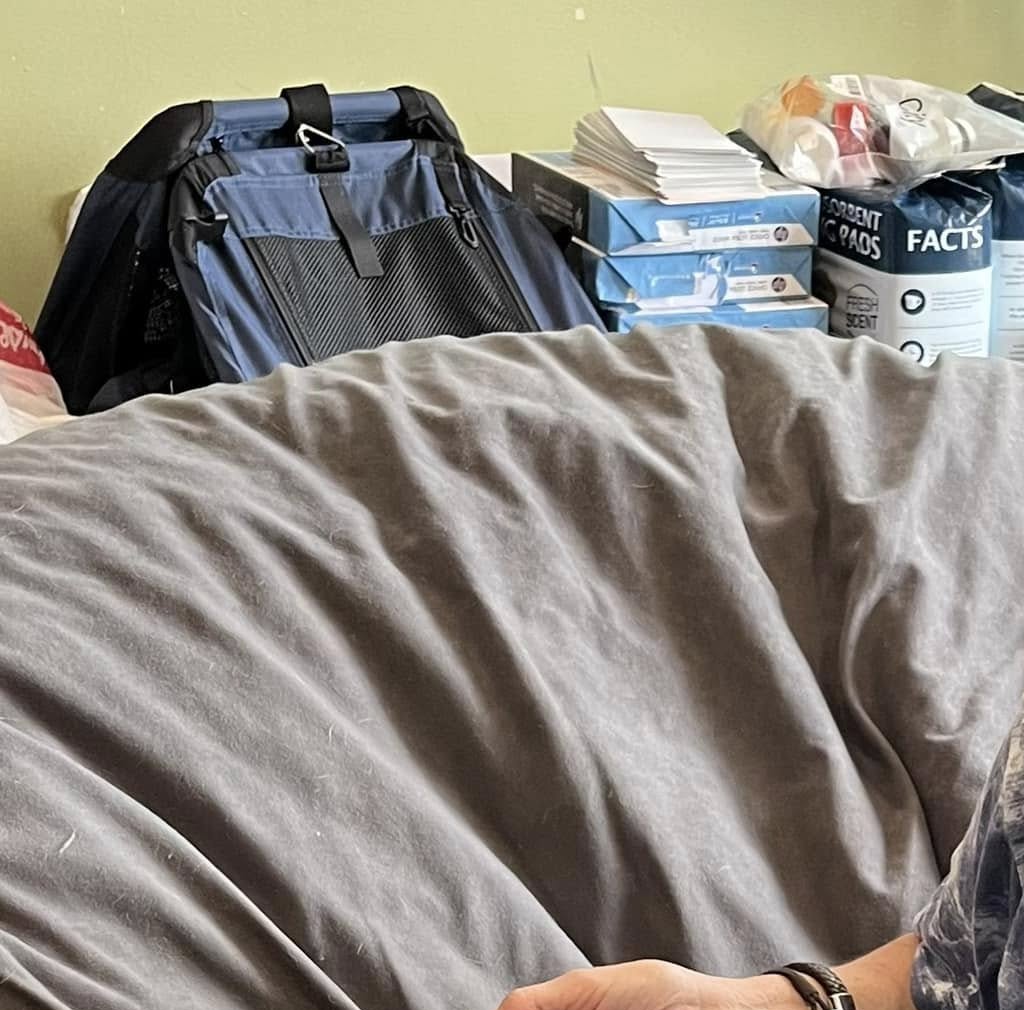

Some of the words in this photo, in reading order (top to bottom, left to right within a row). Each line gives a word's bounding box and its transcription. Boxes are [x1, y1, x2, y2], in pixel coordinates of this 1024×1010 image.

[907, 225, 984, 252] FACTS
[846, 295, 879, 313] FRESH
[846, 314, 878, 330] SCENT
